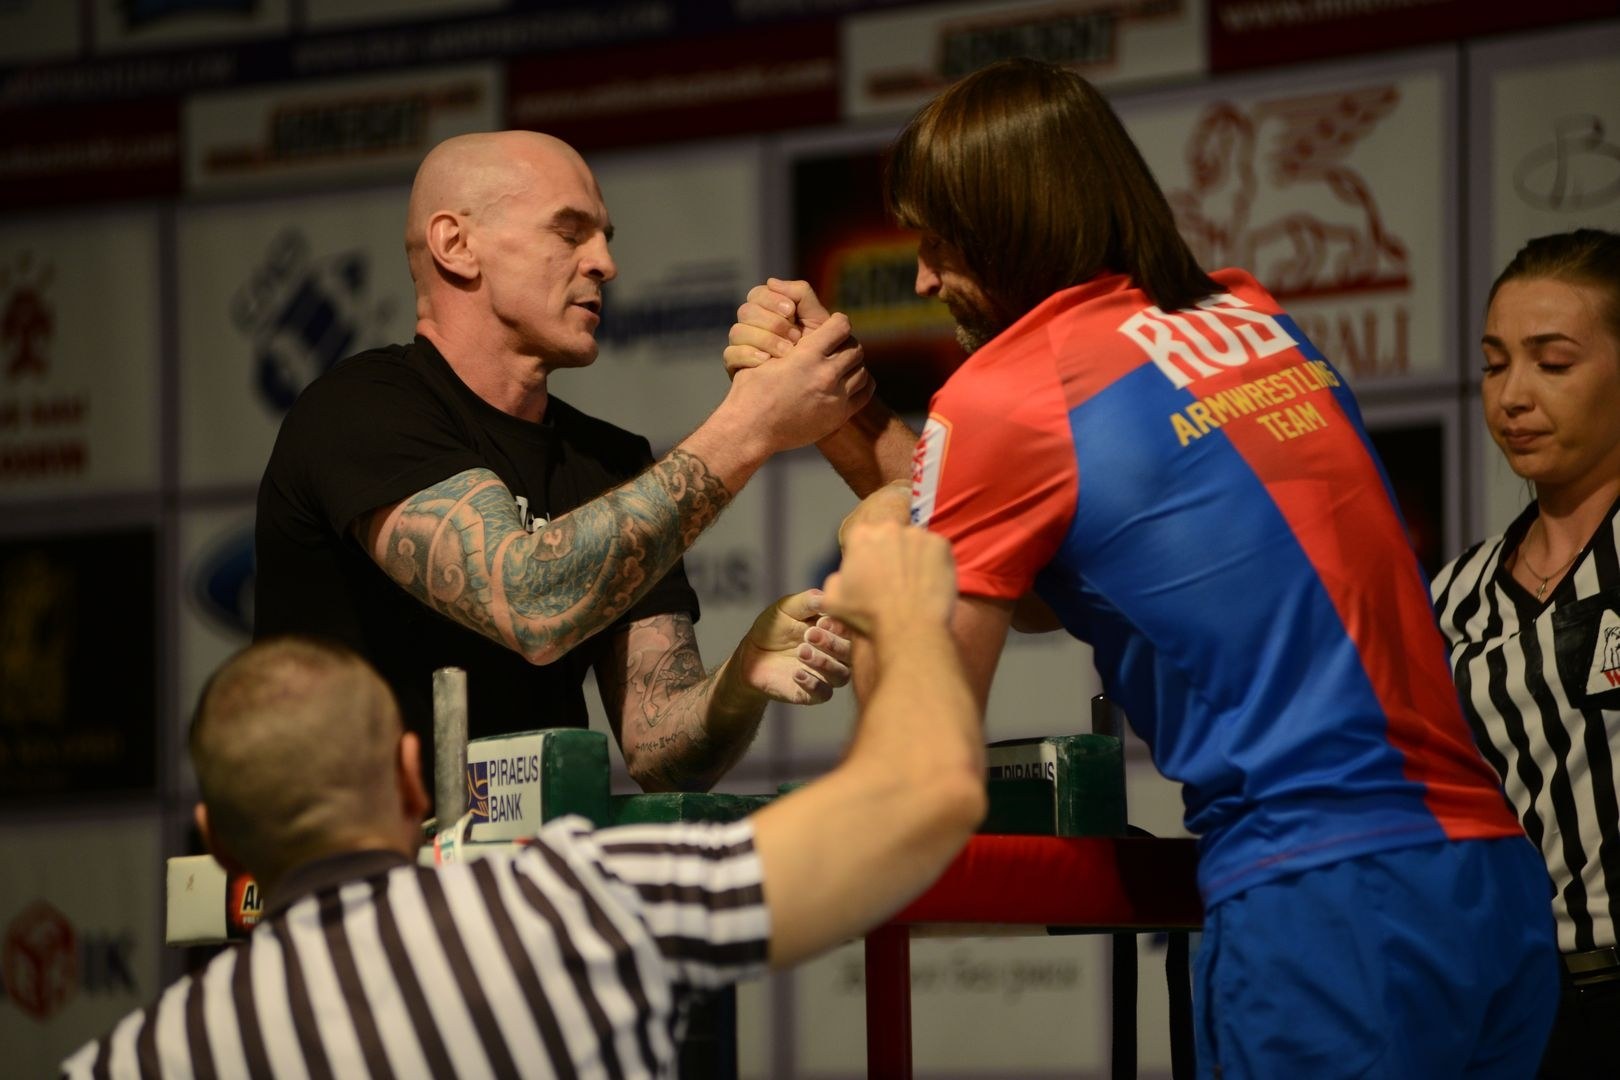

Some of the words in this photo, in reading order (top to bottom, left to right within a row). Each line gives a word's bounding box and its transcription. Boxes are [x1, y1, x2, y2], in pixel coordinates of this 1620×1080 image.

[1117, 293, 1299, 390] RUS
[1169, 359, 1341, 447] ARMWRESTLING
[1256, 401, 1328, 442] TEAM
[489, 755, 539, 787] PIRAEUS
[490, 794, 523, 823] BANK
